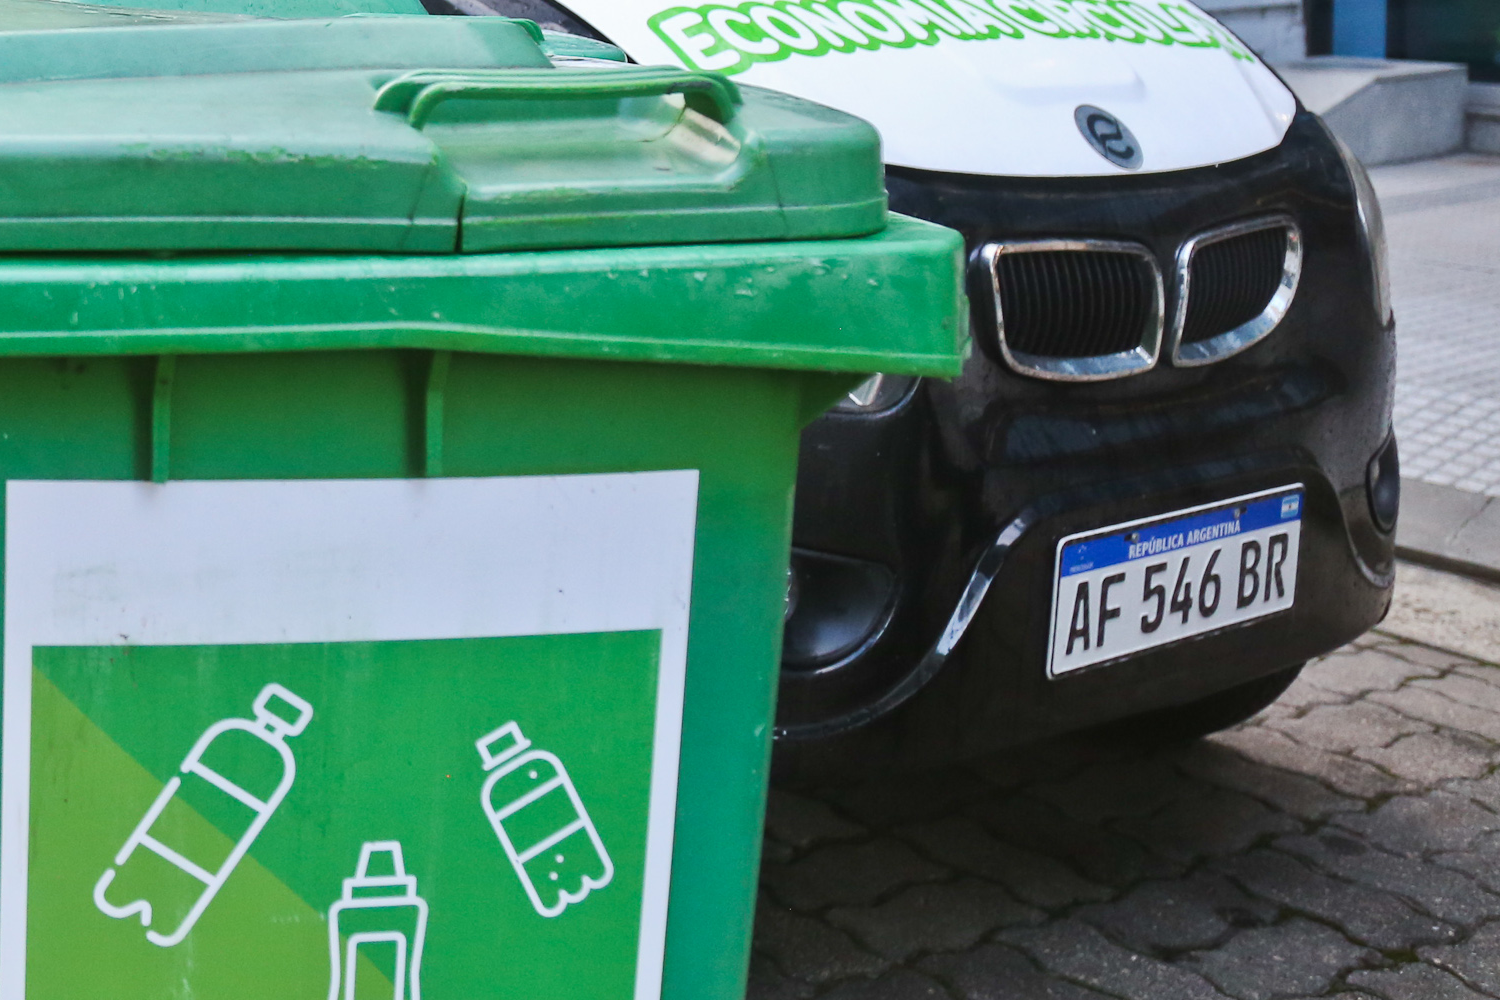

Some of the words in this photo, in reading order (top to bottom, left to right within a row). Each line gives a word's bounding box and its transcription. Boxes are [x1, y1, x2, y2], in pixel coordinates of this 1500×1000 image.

[1128, 534, 1184, 559] REPÚBLICA
[1186, 520, 1241, 547] ARGENTINA
[1065, 572, 1126, 656] AF
[1140, 548, 1222, 635] 546
[1236, 532, 1289, 610] BR
